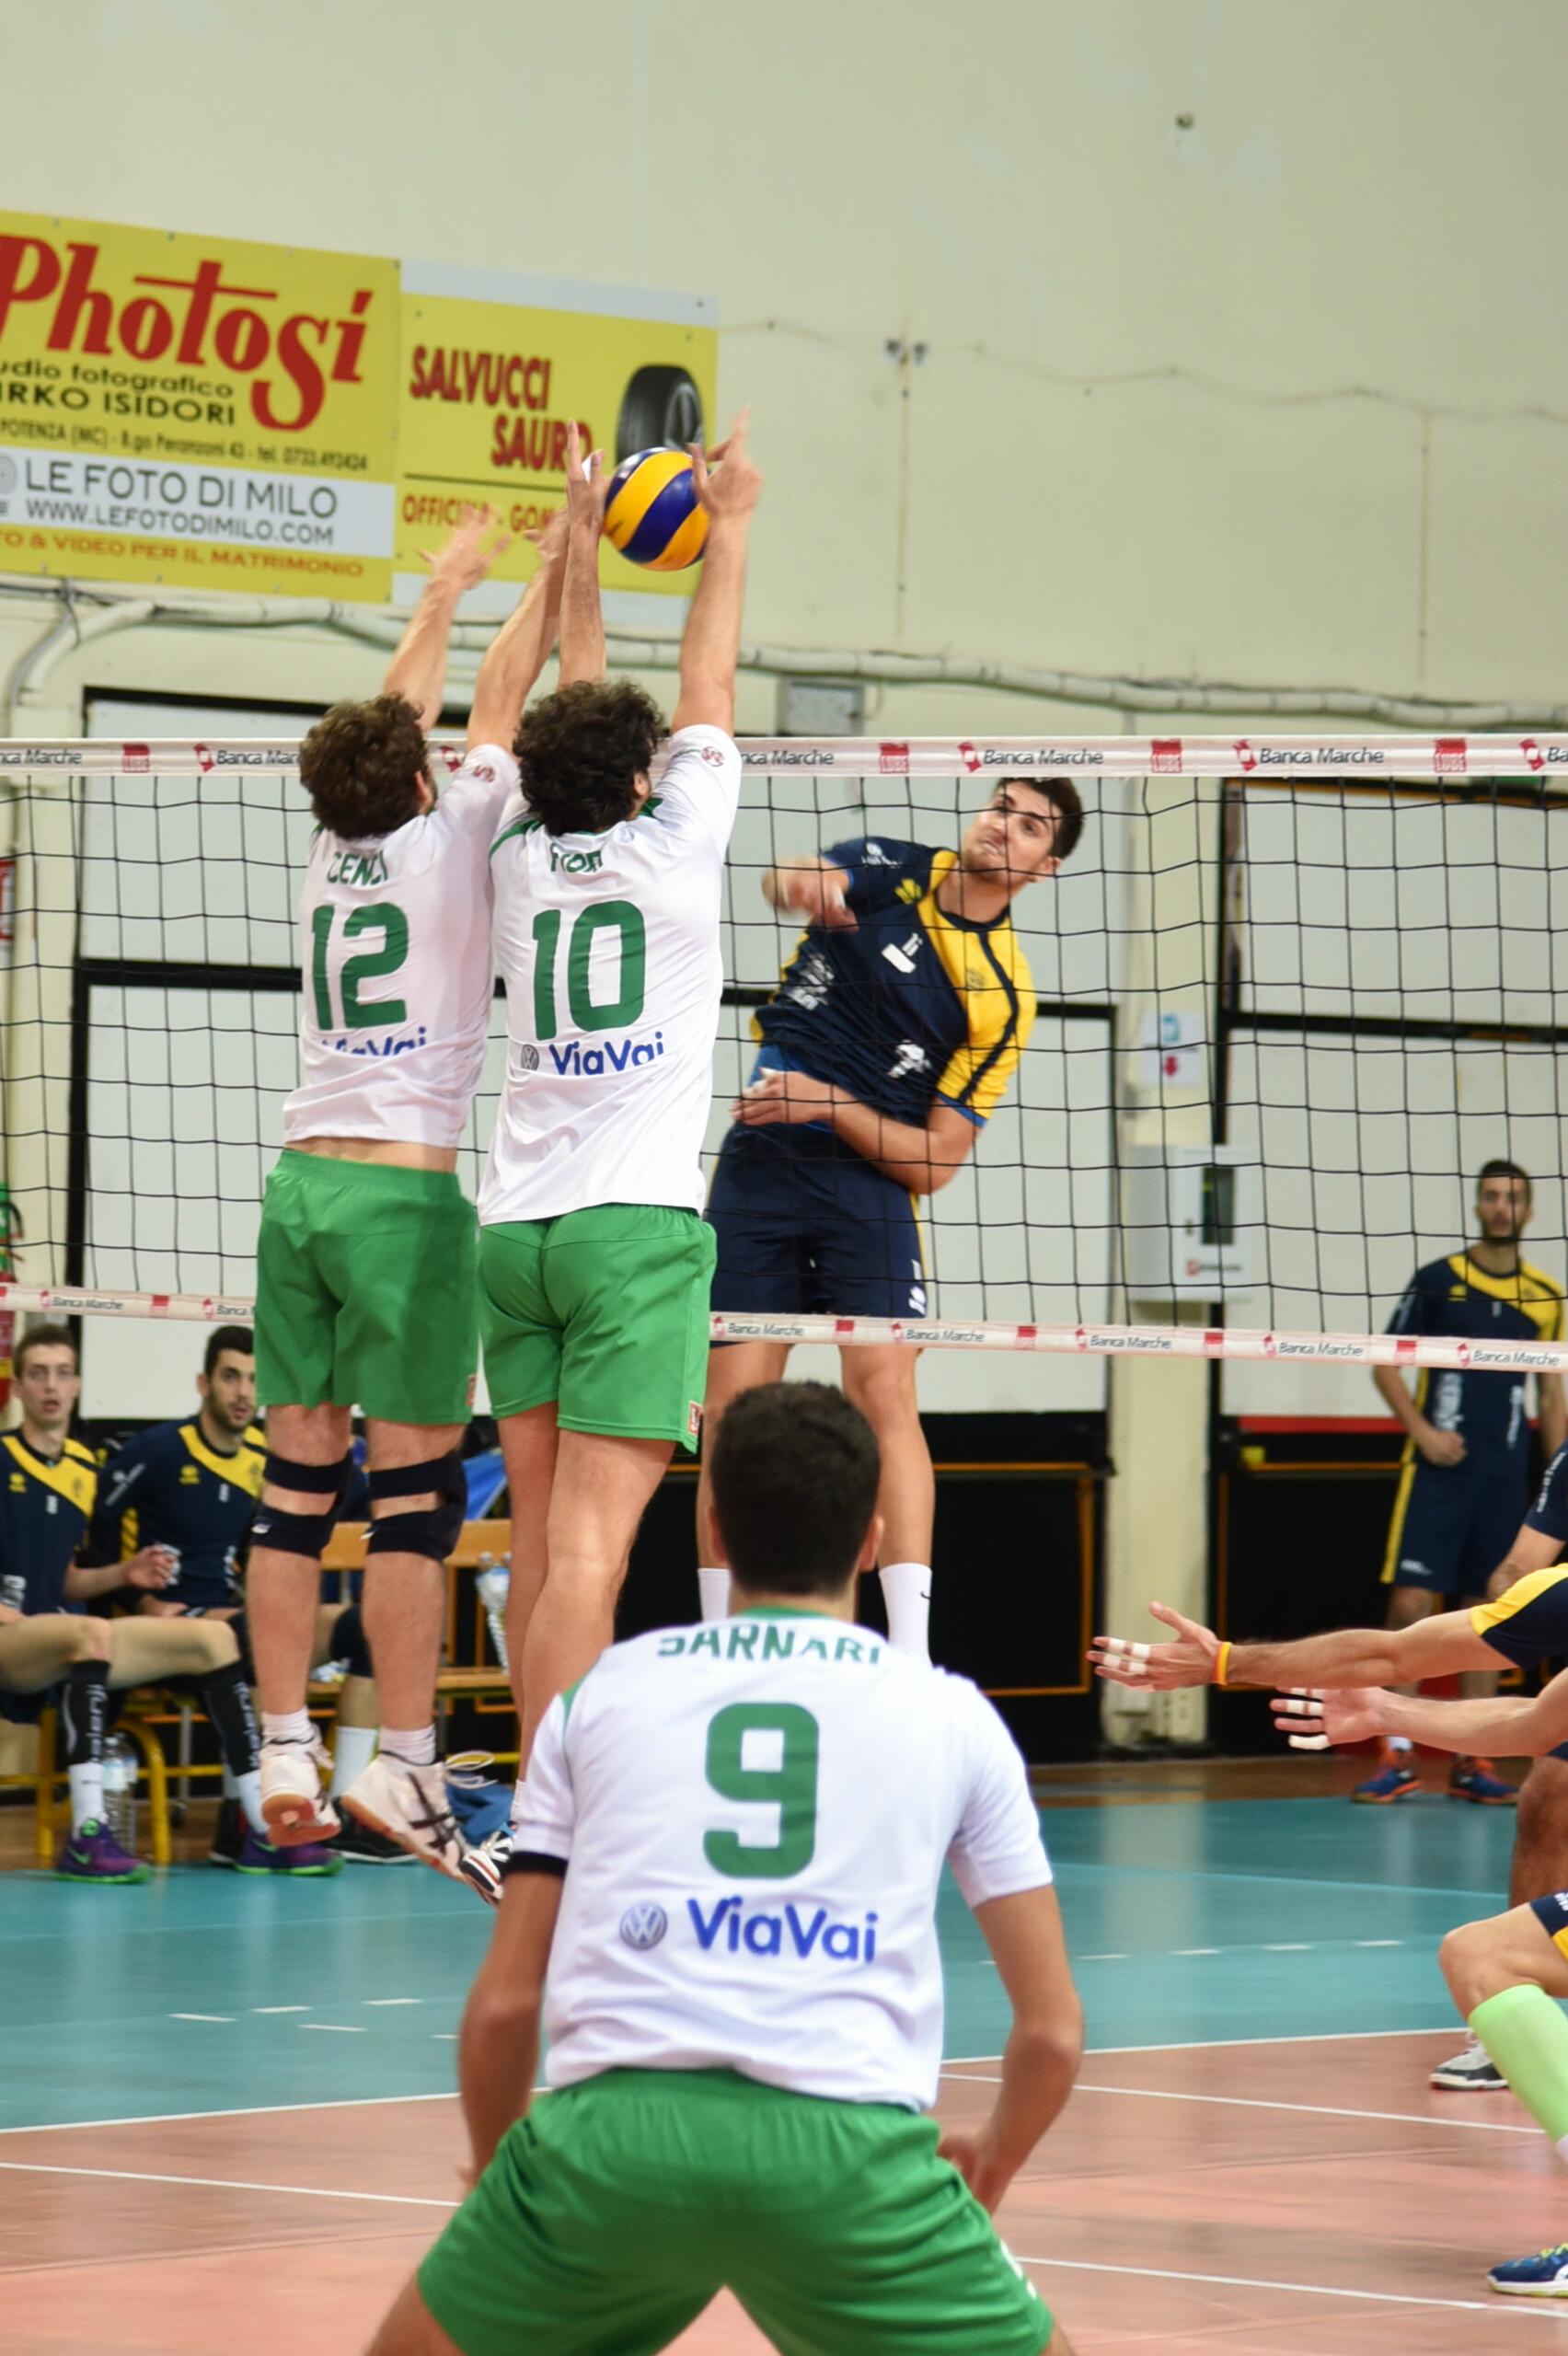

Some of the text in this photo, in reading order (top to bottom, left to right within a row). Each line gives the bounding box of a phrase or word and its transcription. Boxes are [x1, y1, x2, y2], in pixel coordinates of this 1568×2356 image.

[72, 364, 234, 398] fotografico
[409, 344, 551, 410] SALVUCCI
[103, 391, 236, 425] ISIDORI
[26, 458, 338, 519] LE FOTO DI MILO
[26, 498, 334, 545] WWW.LEFOTODIMILO.COM
[53, 534, 125, 557] VIDEO
[132, 540, 178, 560] PER
[210, 549, 364, 579] MATRIMONIO
[25, 748, 82, 765] Marche
[217, 749, 302, 765] Banca Mar
[739, 751, 767, 765] nca
[771, 748, 835, 765] Marche
[983, 748, 1104, 766] Banca Marche
[1259, 746, 1384, 764] Banca Marche
[312, 902, 409, 1031] 12
[533, 900, 646, 1041] 10
[548, 1031, 664, 1077] ViaVai
[52, 1297, 124, 1311] Banca Marche
[216, 1304, 248, 1317] Banca
[727, 1322, 804, 1337] Banca Marche
[905, 1329, 986, 1344] Banca Marche
[1090, 1334, 1172, 1350] Banca Marche
[1278, 1341, 1364, 1357] Banca Marche
[1473, 1349, 1561, 1367] Banca Marche
[703, 1703, 819, 1879] 9
[687, 1896, 879, 1963] ViaVai
